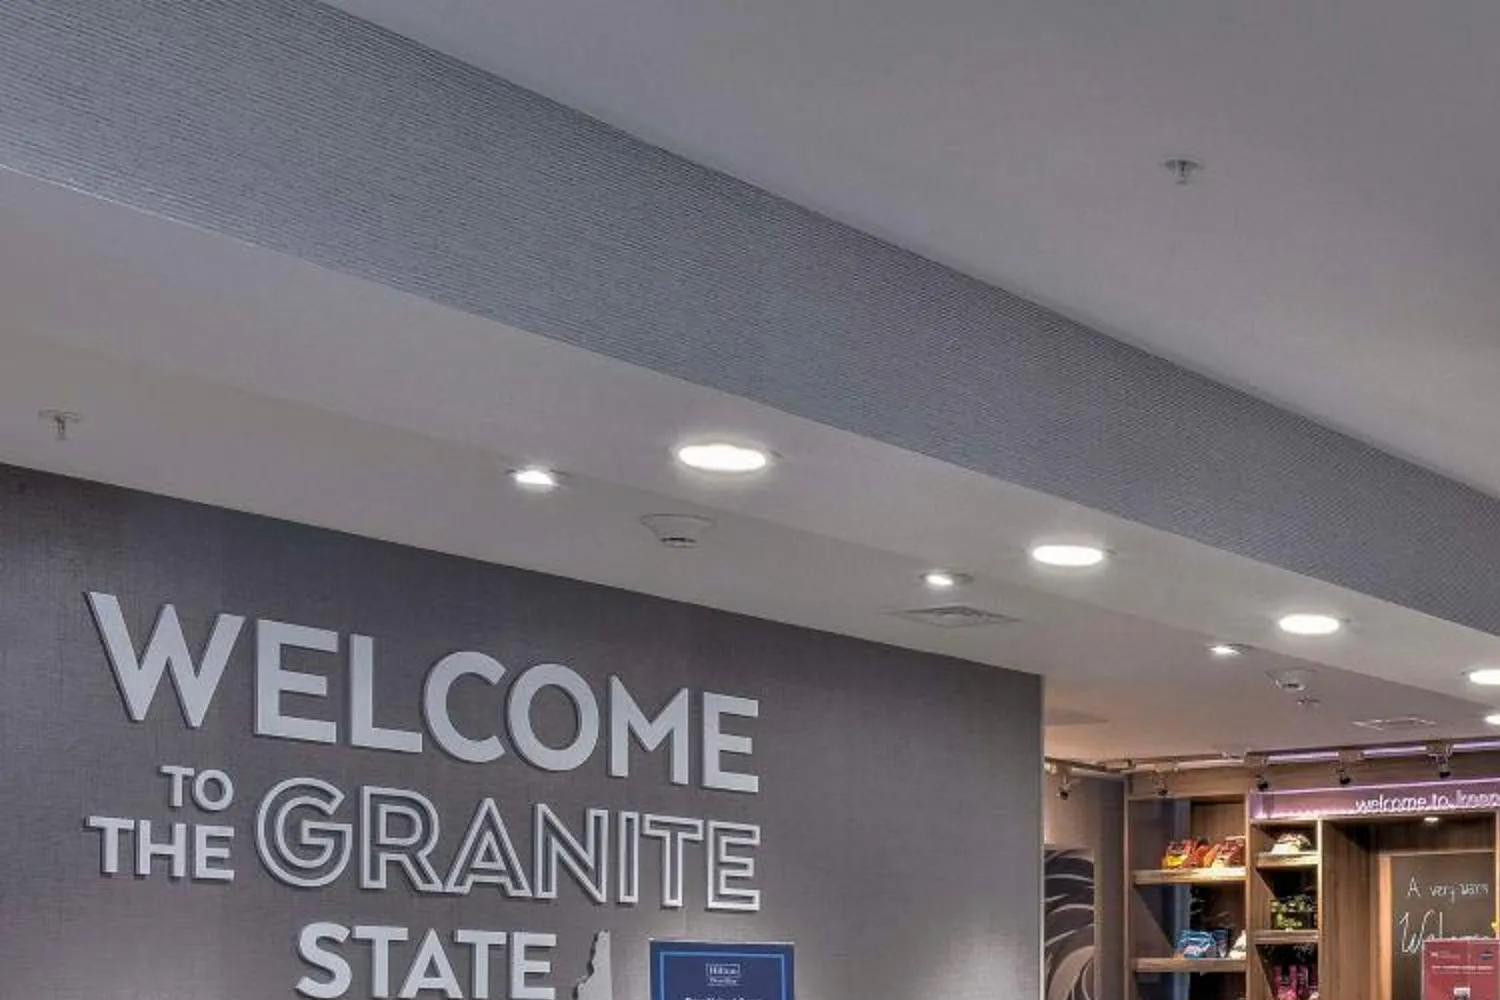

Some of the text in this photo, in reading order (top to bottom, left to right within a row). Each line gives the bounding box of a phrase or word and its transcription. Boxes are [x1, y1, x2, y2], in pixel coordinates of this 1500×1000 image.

[86, 590, 760, 793] WELCOME
[161, 764, 234, 812] TO
[1355, 794, 1427, 813] welcome
[1432, 793, 1449, 809] to
[88, 815, 235, 881] THE
[256, 777, 761, 911] GRANITE
[1407, 876, 1421, 897] A
[297, 921, 557, 1000] STATE
